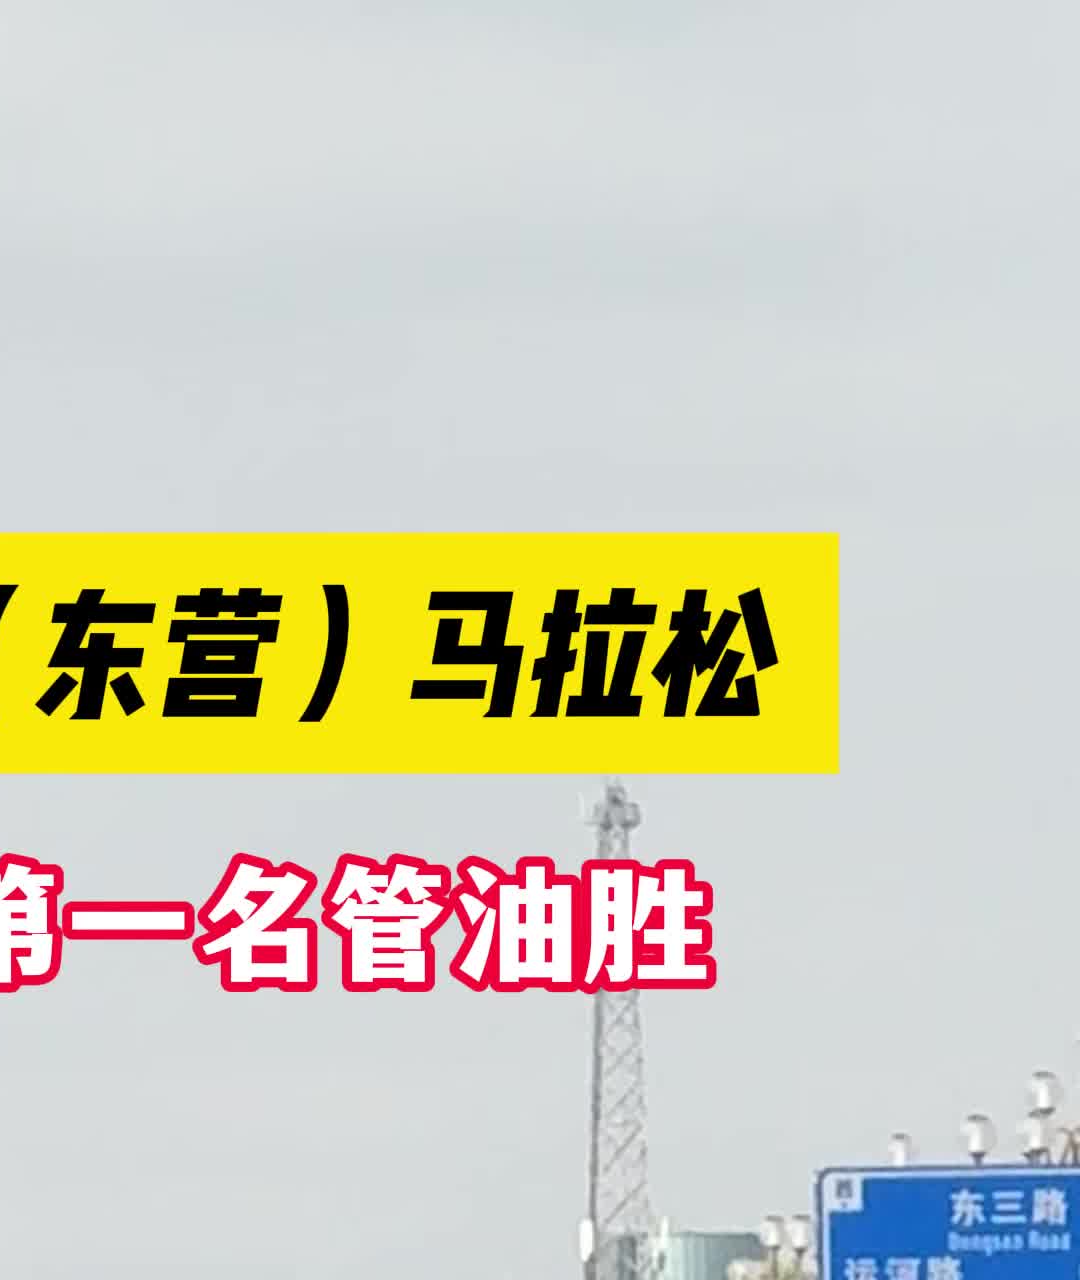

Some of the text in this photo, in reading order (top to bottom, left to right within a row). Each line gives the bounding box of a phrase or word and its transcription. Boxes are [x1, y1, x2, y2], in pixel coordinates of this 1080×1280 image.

[948, 1188, 1068, 1227] 东三路
[947, 1229, 1071, 1257] Dongsan Road
